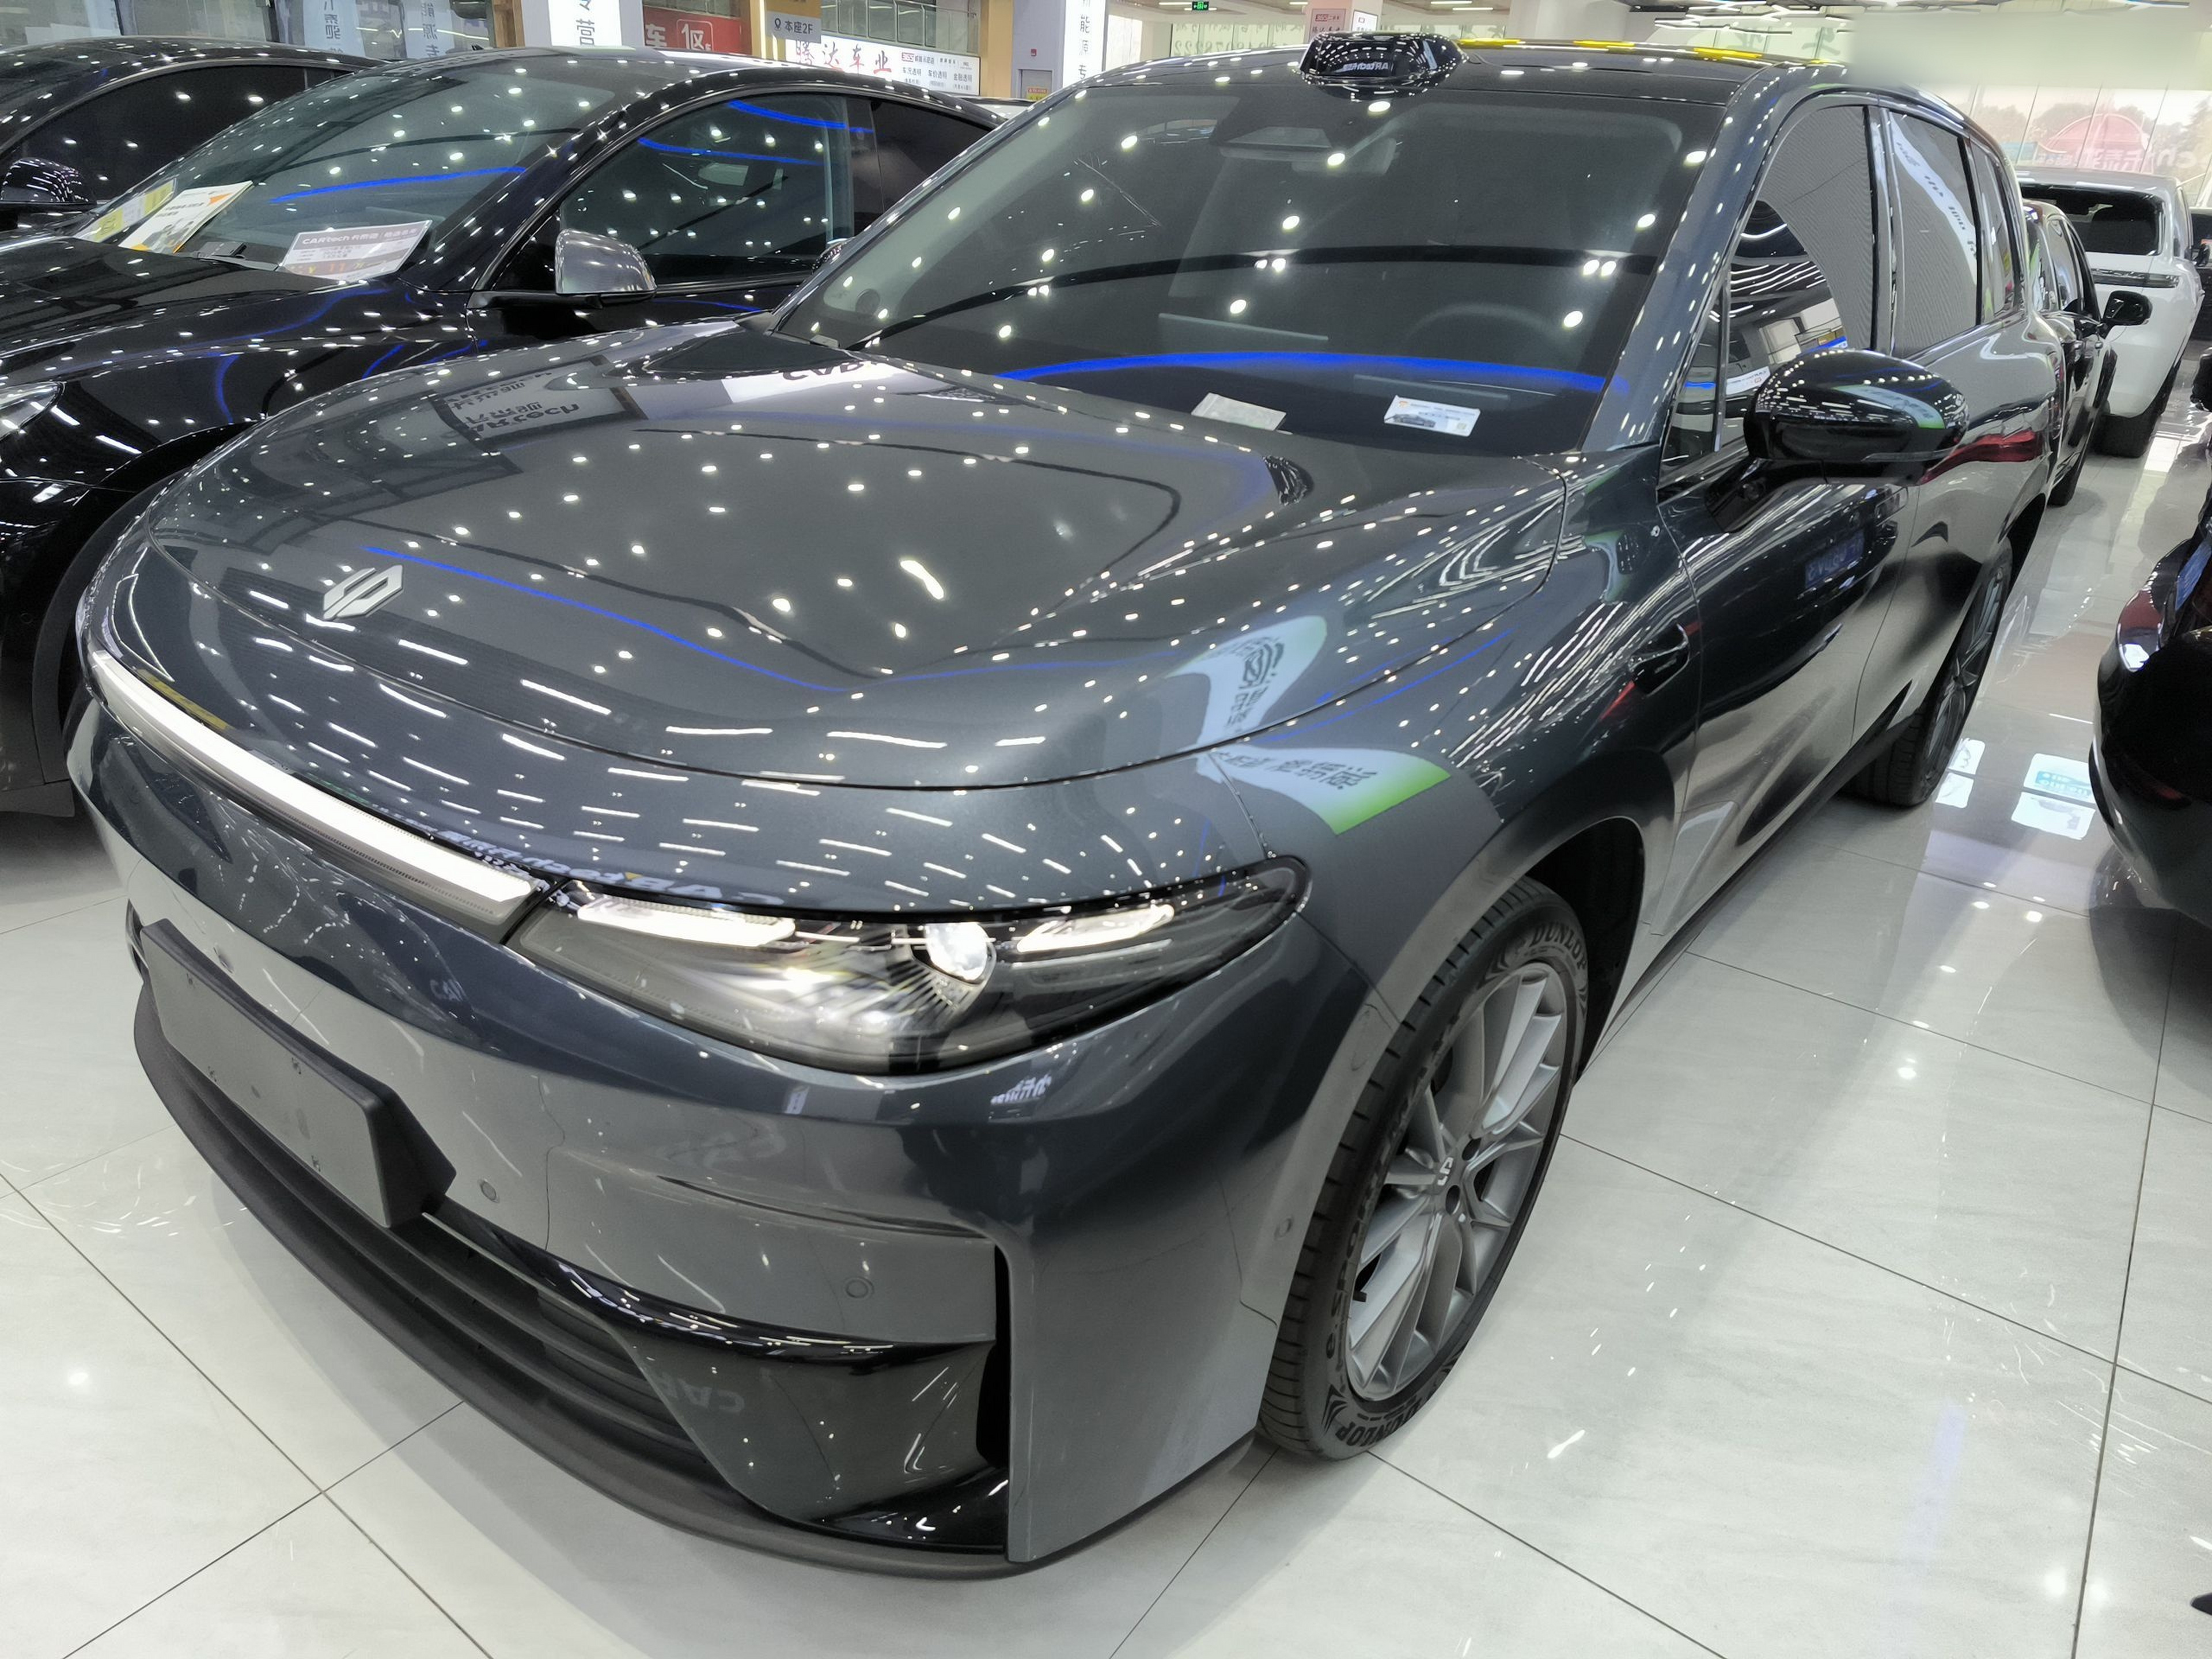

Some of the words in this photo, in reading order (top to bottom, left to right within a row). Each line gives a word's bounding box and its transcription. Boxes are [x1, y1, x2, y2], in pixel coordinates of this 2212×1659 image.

[681, 24, 704, 51] 1区
[785, 20, 813, 35] 本座2F
[303, 236, 350, 245] CARtech
[1529, 922, 1588, 971] DUNLOP
